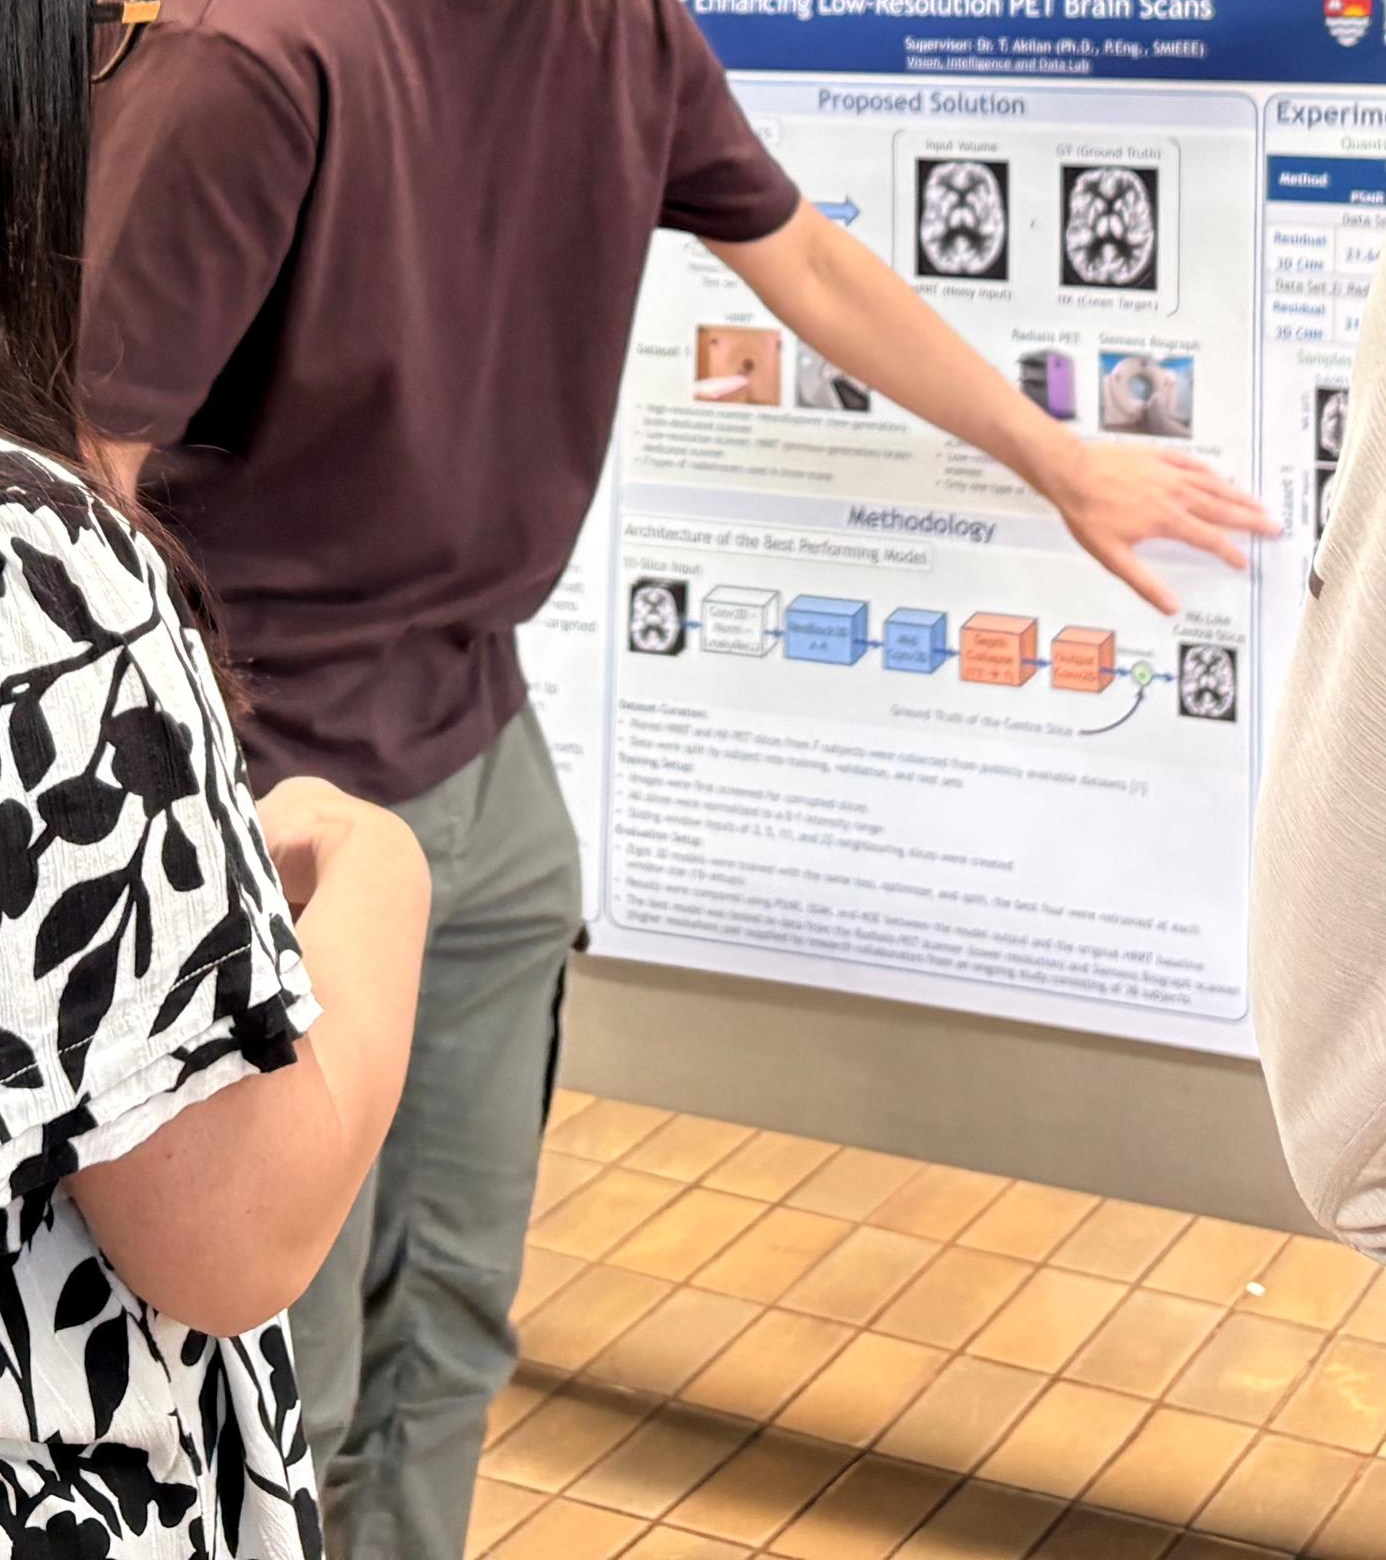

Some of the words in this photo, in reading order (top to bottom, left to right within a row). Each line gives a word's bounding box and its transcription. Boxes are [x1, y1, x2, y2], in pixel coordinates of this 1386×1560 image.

[905, 35, 972, 53] Supervisor:
[977, 37, 993, 52] Dr.
[1013, 38, 1051, 53] Akilan
[907, 56, 943, 70] Vision,
[946, 56, 1011, 71] Intelligence
[1014, 58, 1036, 71] and
[1039, 58, 1064, 72] Data
[1068, 59, 1091, 73] Lab
[818, 90, 922, 115] Proposed
[929, 92, 1026, 116] Solution
[925, 140, 954, 153] Input
[958, 141, 998, 153] Volume
[1279, 172, 1330, 188] Method
[1342, 214, 1371, 227] Data
[1273, 232, 1327, 246] Residual
[1272, 302, 1326, 316] Residual
[847, 505, 997, 544] Methodology
[624, 522, 712, 545] Architecture
[717, 530, 732, 545] of
[735, 533, 759, 549] the
[763, 536, 795, 552] Best
[799, 538, 880, 564] Performing
[883, 547, 927, 566] Model
